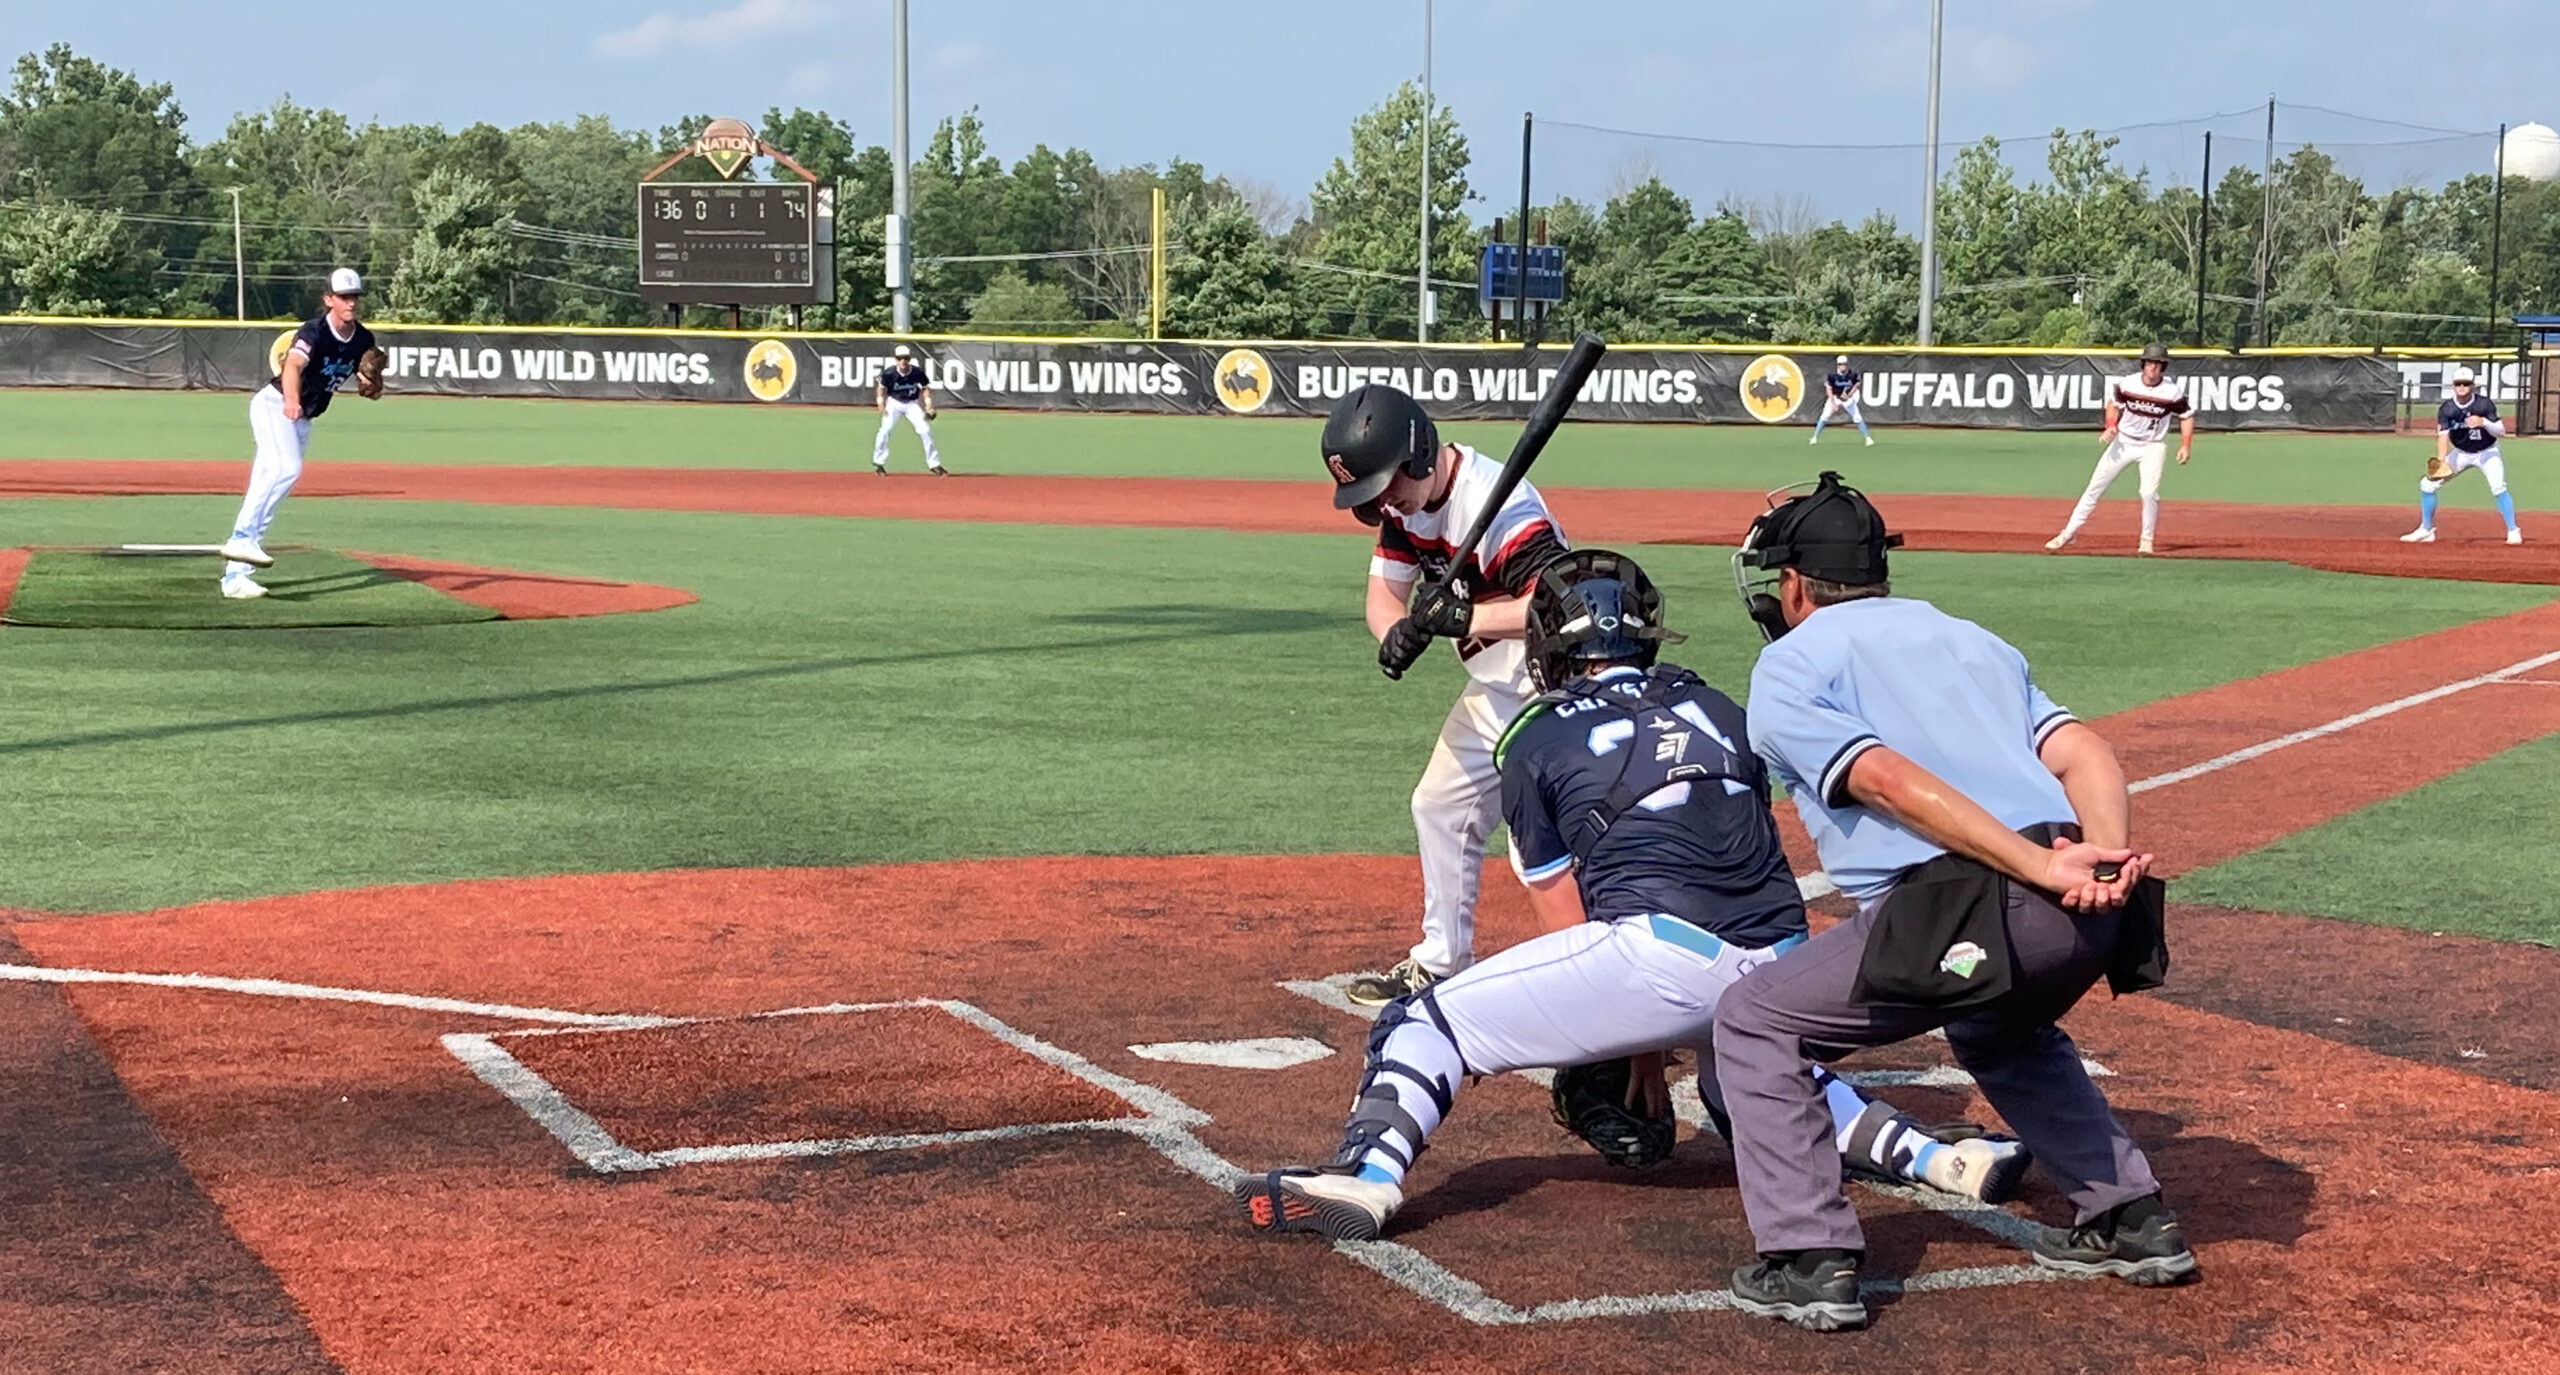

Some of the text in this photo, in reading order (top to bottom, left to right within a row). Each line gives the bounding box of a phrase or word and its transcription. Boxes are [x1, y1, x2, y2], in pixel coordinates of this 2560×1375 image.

[697, 137, 756, 155] NATION
[654, 199, 683, 220] 136
[695, 200, 707, 221] 0
[784, 200, 806, 219] 74
[377, 346, 502, 379] UFFALO
[511, 349, 595, 381] WILD
[821, 356, 966, 391] BUFLO
[975, 360, 1061, 392] WILD
[1862, 372, 2014, 409] UFFALO
